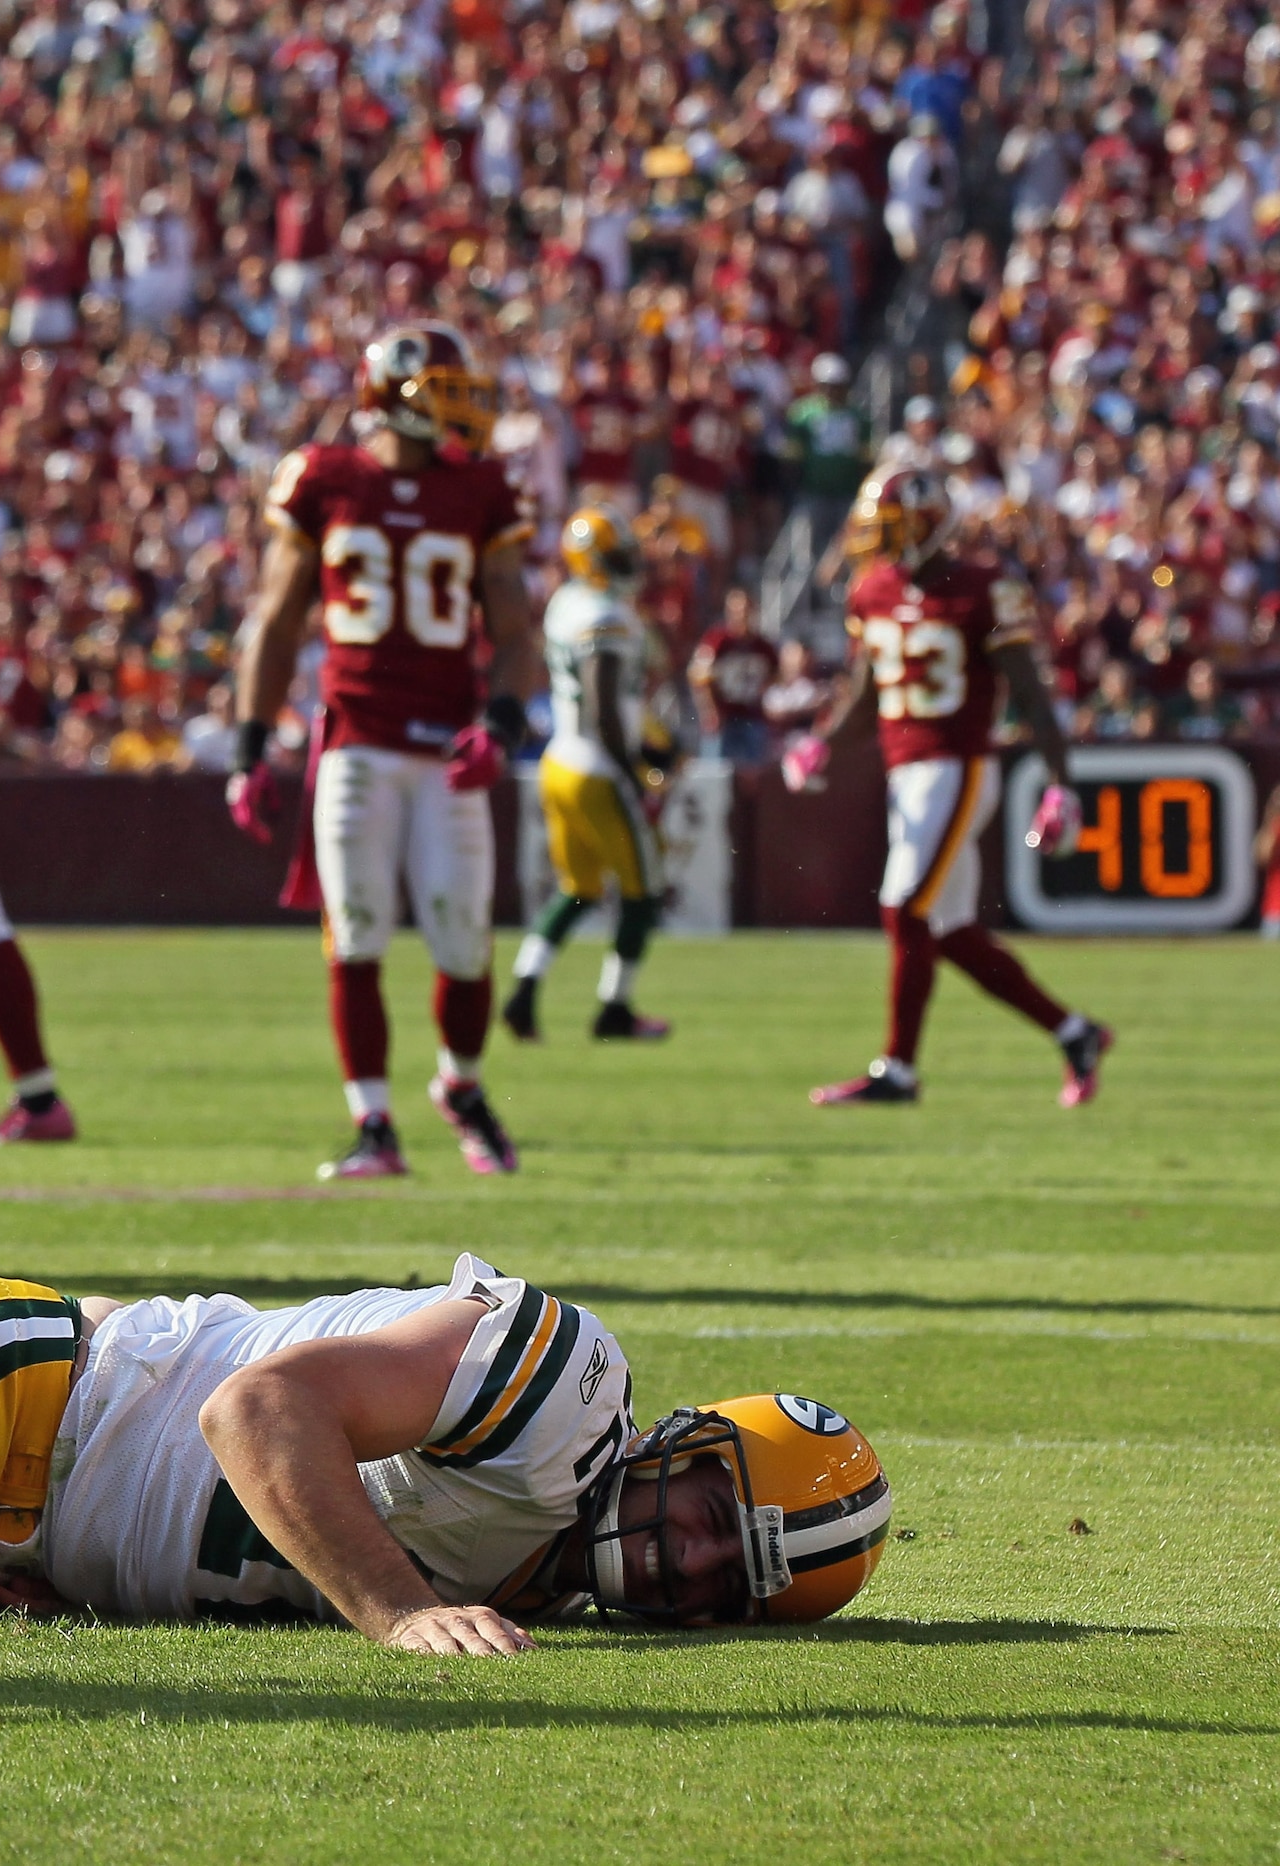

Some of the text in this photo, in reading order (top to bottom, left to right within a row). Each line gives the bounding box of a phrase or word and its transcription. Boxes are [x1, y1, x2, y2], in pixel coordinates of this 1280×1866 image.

[321, 523, 476, 650] 30
[1077, 777, 1213, 898] 40
[767, 1526, 783, 1572] Riddell
